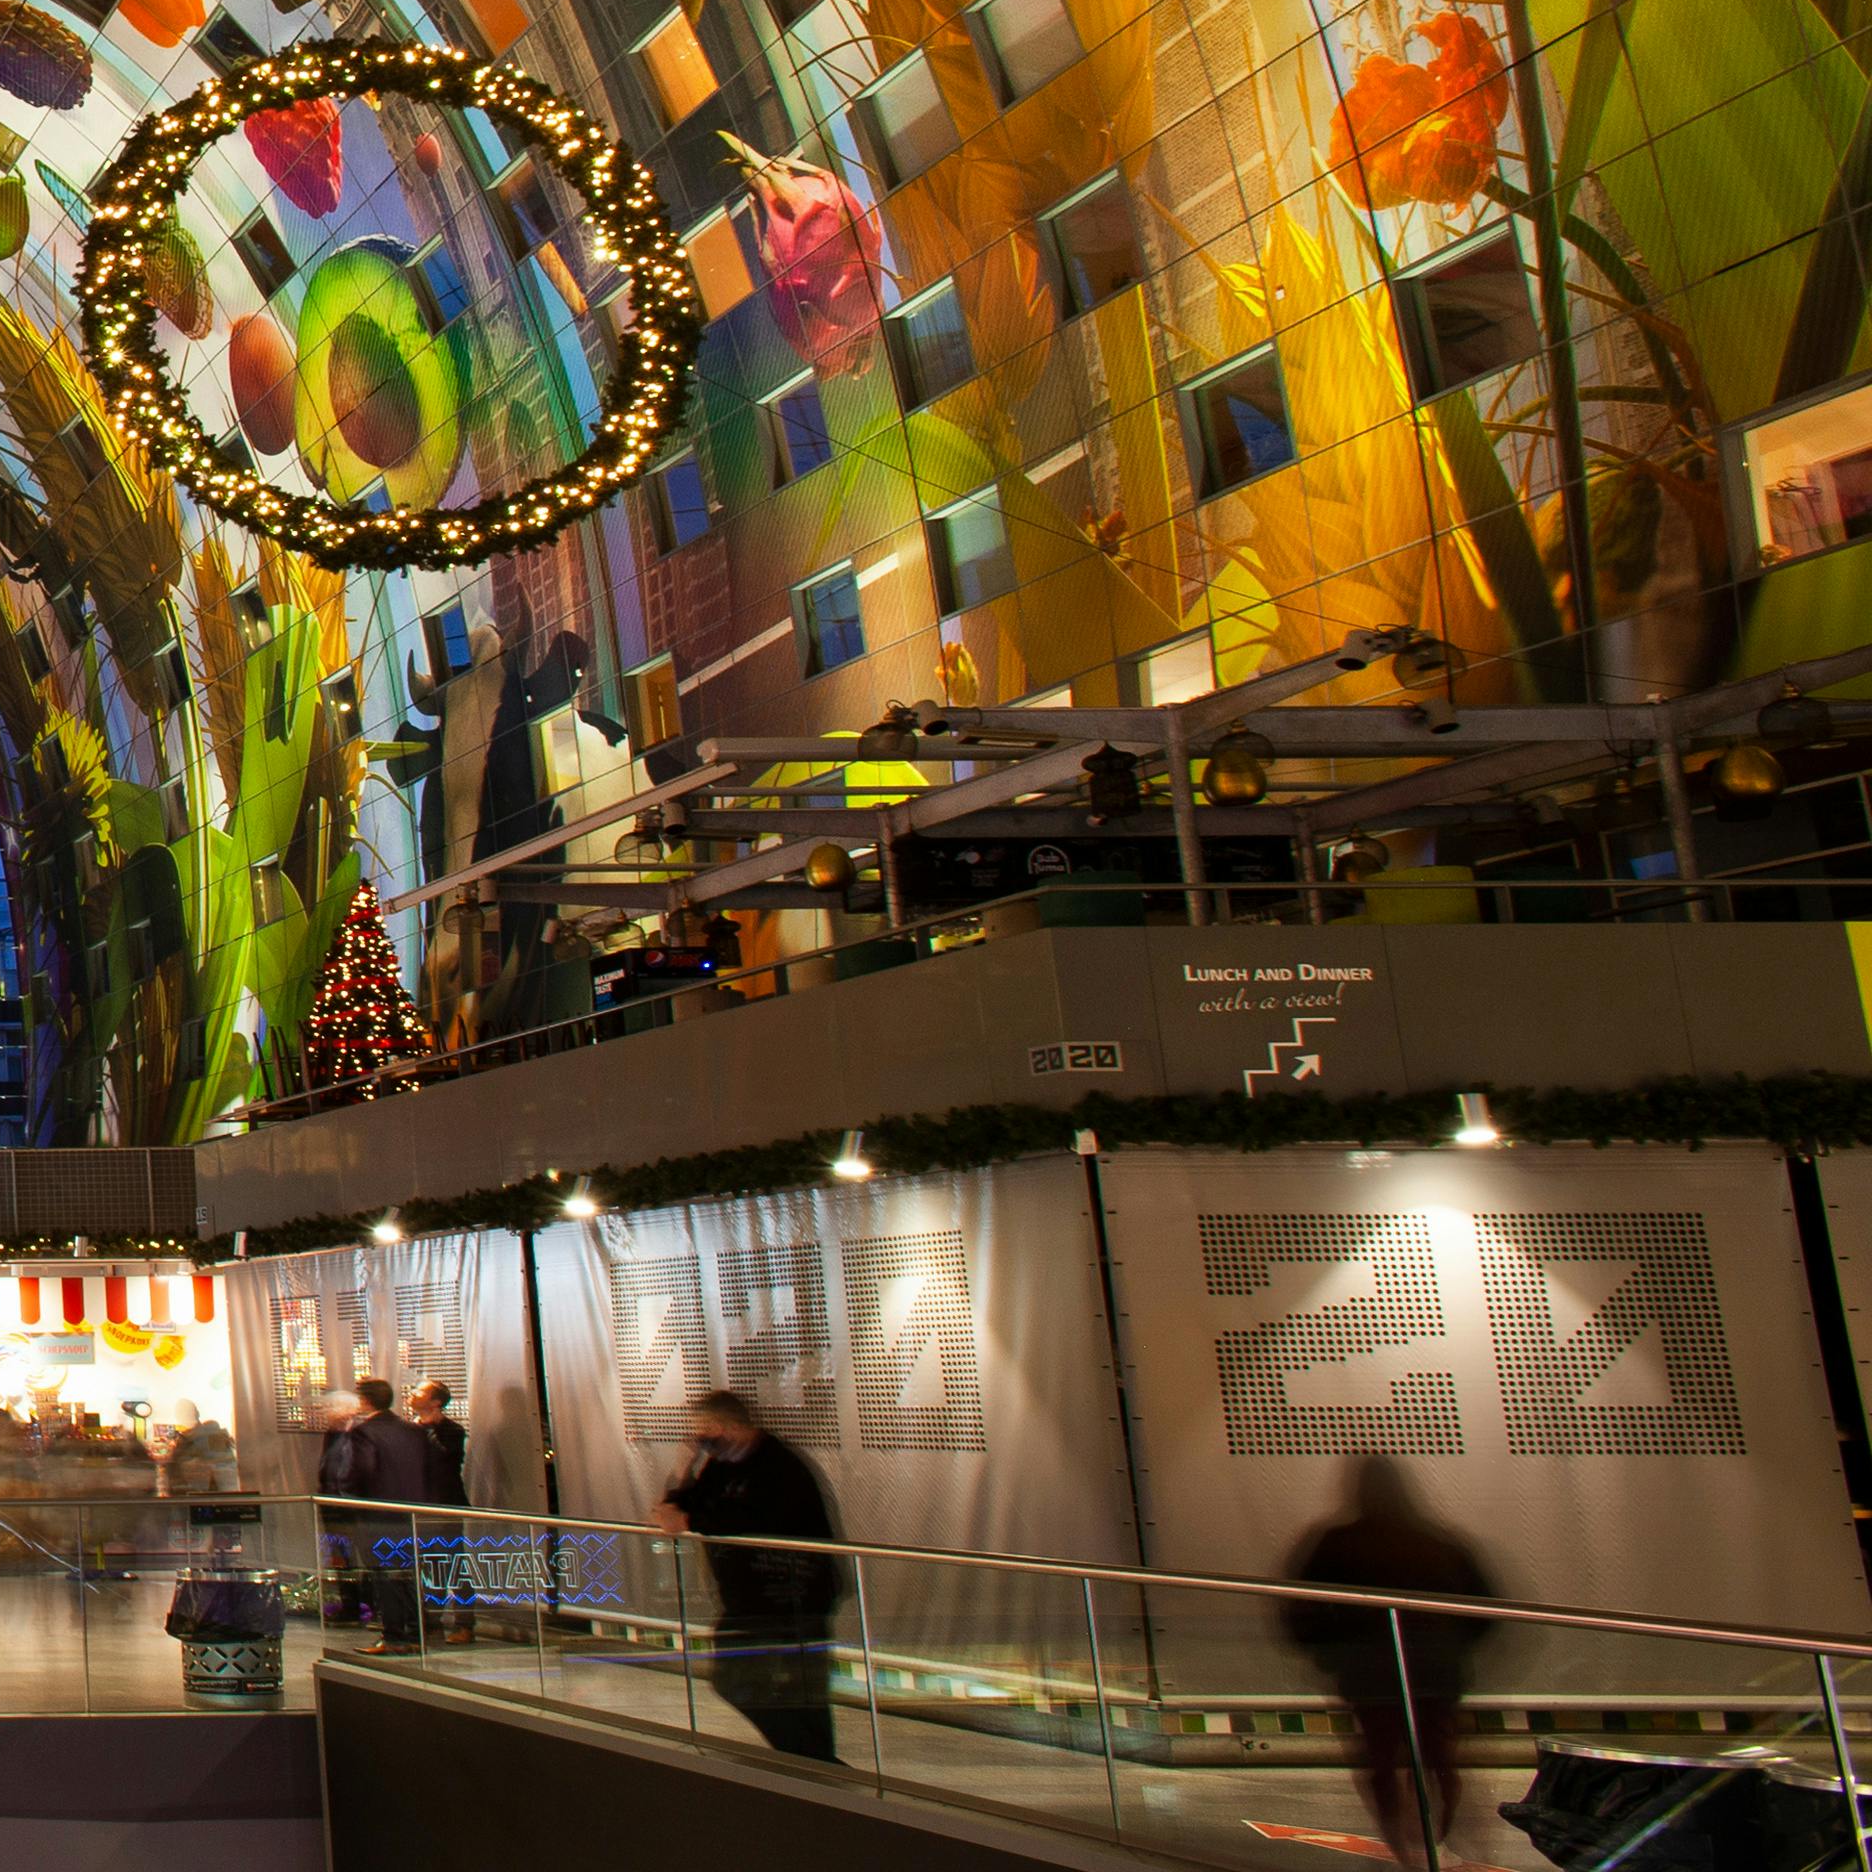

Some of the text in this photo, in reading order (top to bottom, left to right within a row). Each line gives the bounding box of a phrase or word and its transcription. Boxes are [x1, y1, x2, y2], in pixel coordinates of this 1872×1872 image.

[1199, 981, 1345, 1013] with a view!
[1197, 1212, 1747, 1457] 20
